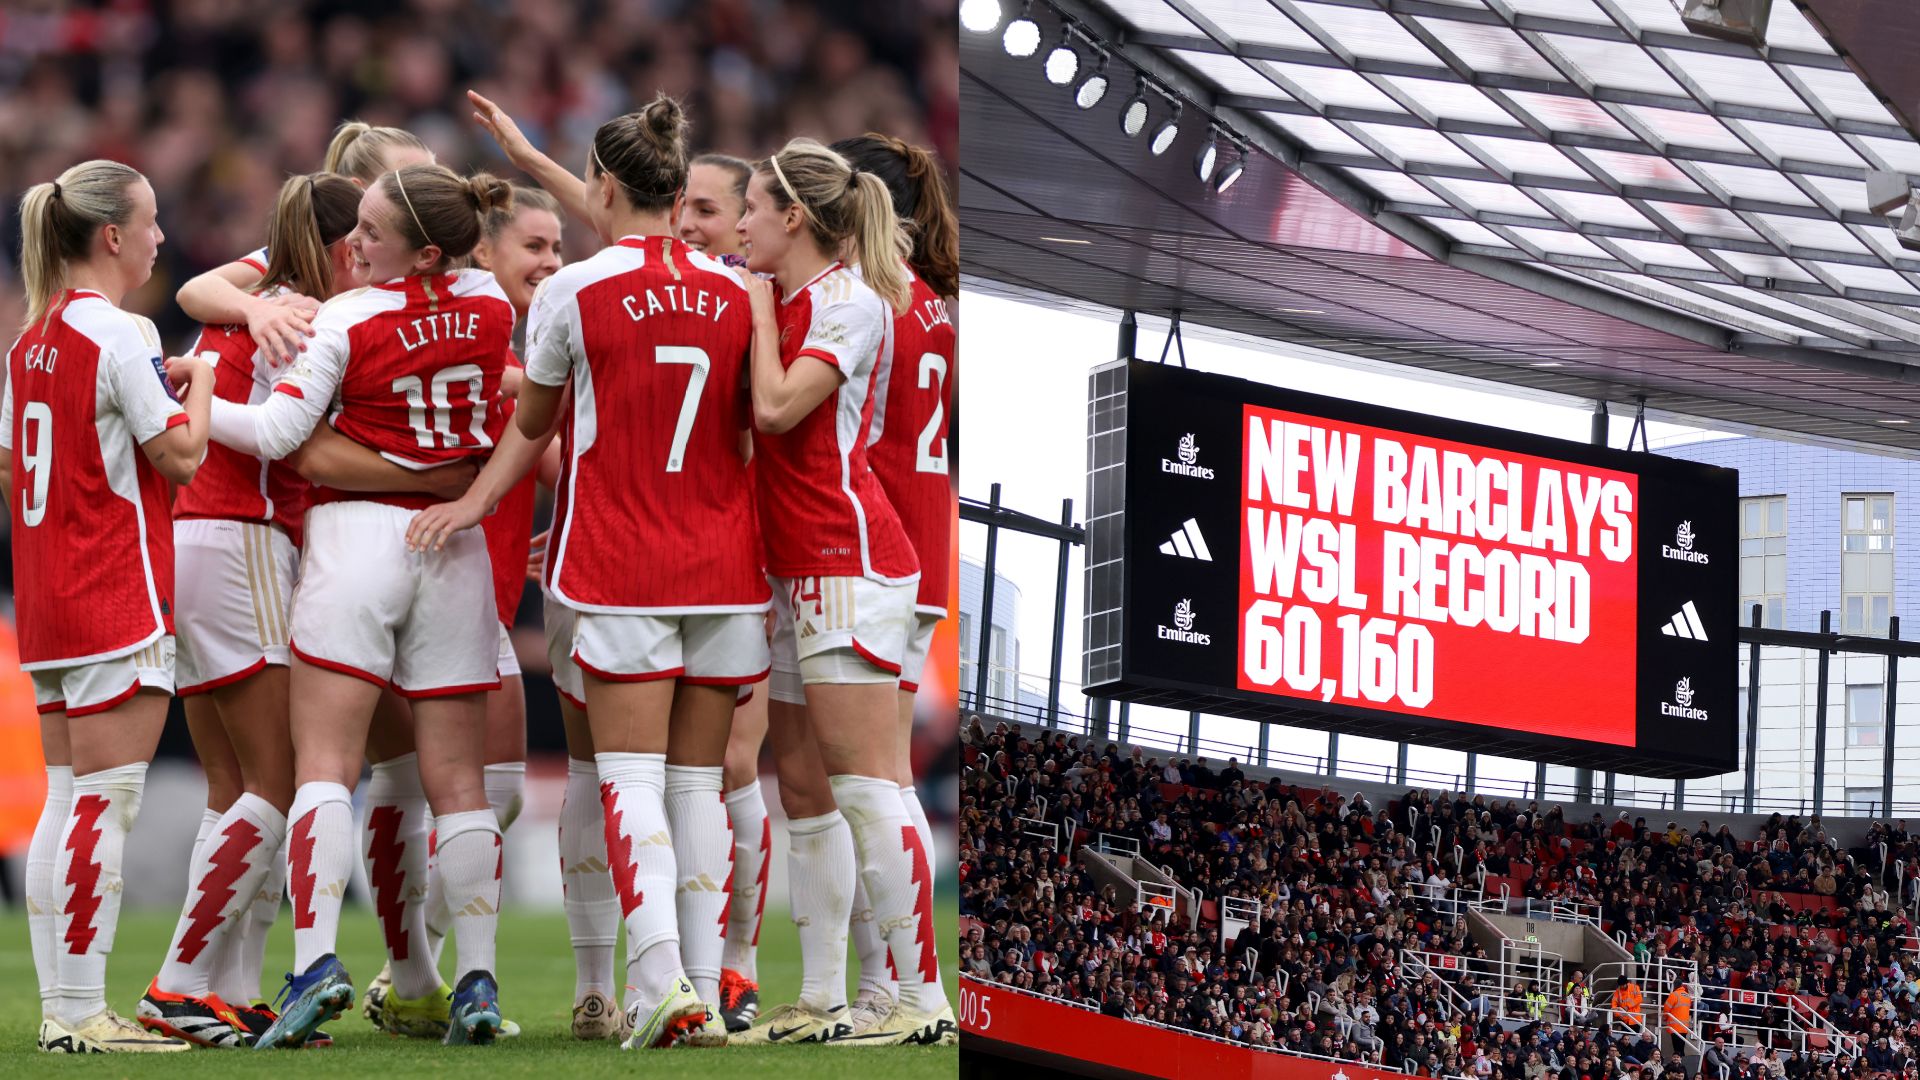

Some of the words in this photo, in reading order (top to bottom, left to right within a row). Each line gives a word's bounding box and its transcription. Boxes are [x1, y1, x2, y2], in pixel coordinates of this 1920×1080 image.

[622, 285, 729, 322] CATLEY
[915, 299, 953, 333] L.CO
[396, 312, 480, 351] LITTLE
[392, 363, 494, 448] 10
[655, 345, 711, 473] 7
[22, 401, 53, 527] 9
[1162, 458, 1215, 480] Emirates
[1247, 415, 1361, 517] NEW
[1373, 437, 1633, 563] BARCLAYS
[1662, 544, 1709, 565] Emirates
[1247, 506, 1368, 610] WSL
[1383, 529, 1591, 645] RECORD
[1158, 624, 1211, 646] Emirates
[1244, 598, 1435, 709] 60,160
[1661, 702, 1708, 721] Emirates
[1526, 922, 1535, 934] 118
